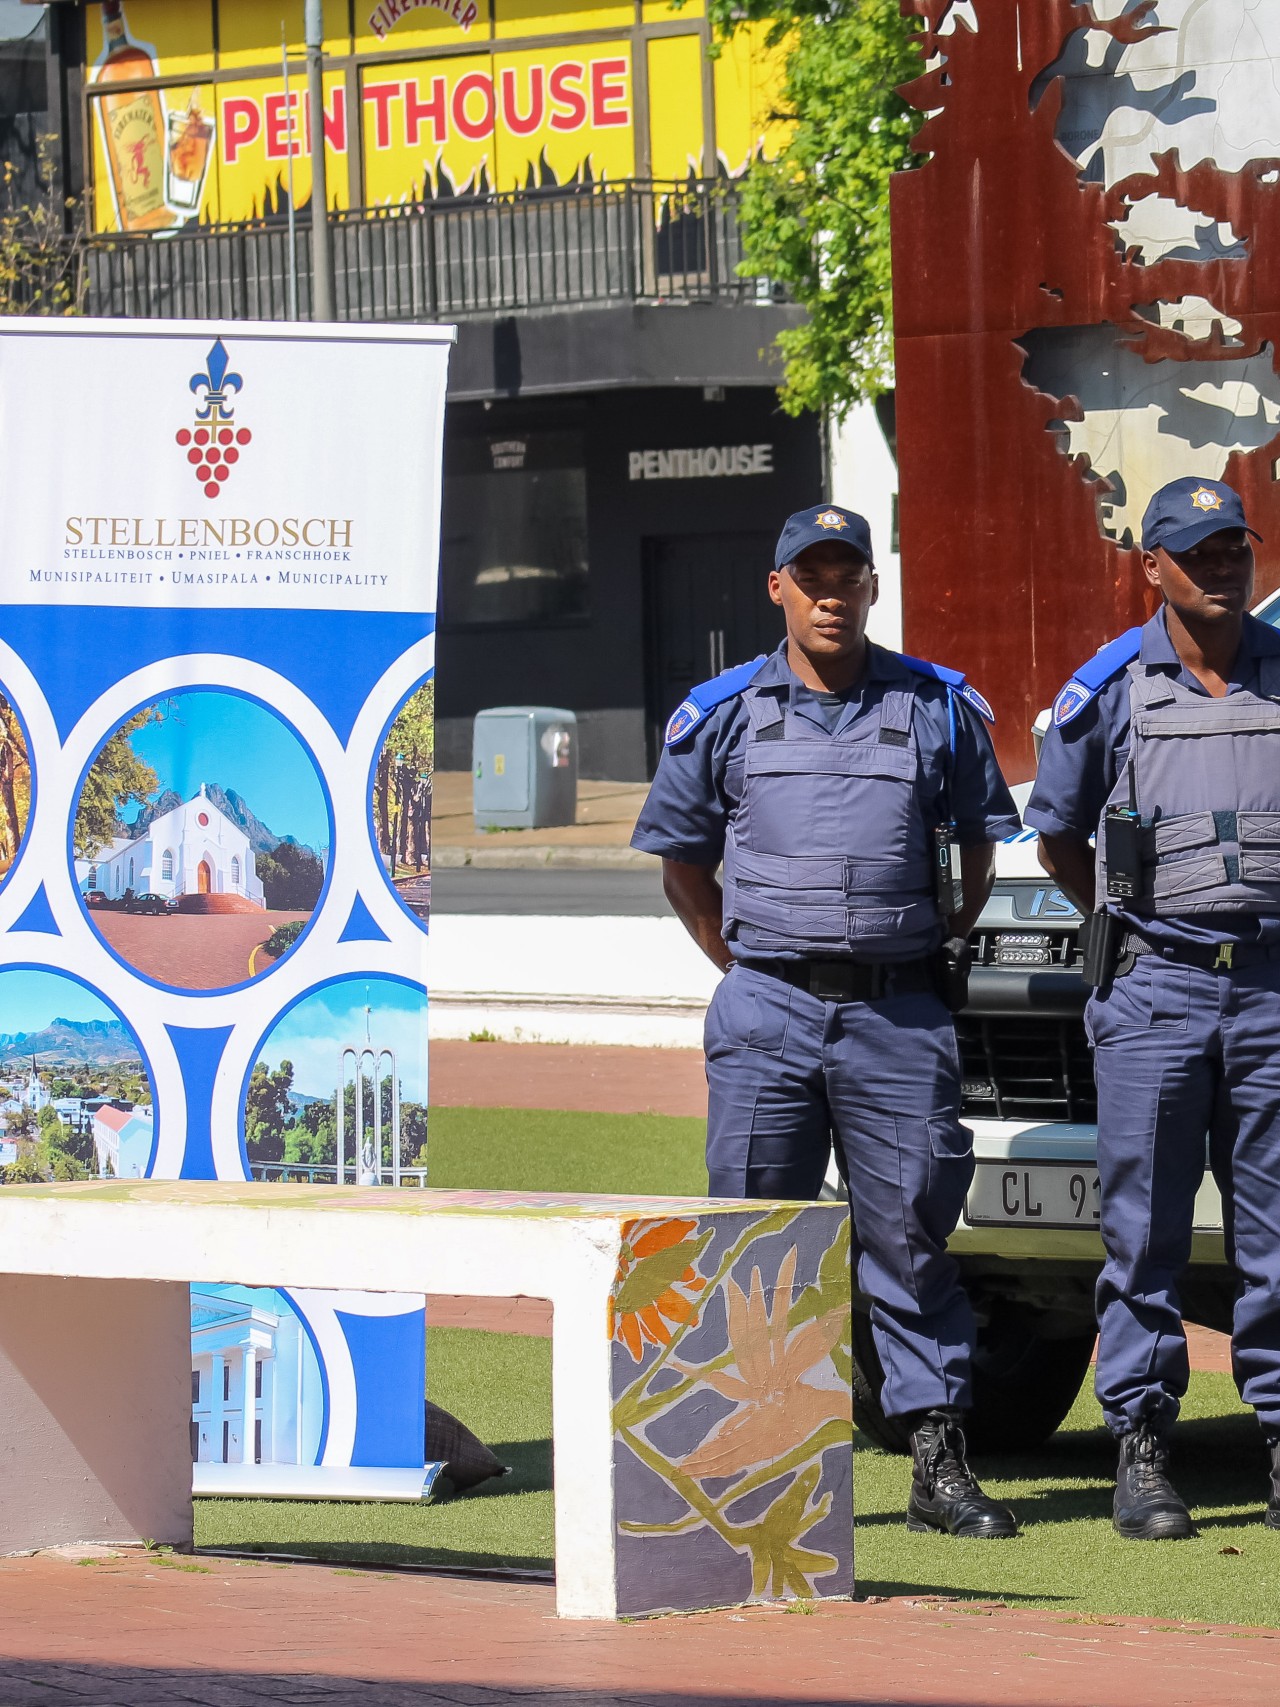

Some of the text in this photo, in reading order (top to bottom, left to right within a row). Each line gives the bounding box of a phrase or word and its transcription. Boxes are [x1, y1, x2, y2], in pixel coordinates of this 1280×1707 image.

[629, 444, 774, 480] PENTHOUSE
[65, 516, 354, 548] STELLENBOSCH
[64, 549, 351, 562] STELLENBOSCH PNIEL FRANSCHHOEK
[30, 569, 389, 586] MUNISIPALITEIT UMASIPALA MUNICIPALITY
[1002, 1171, 1043, 1217] CL
